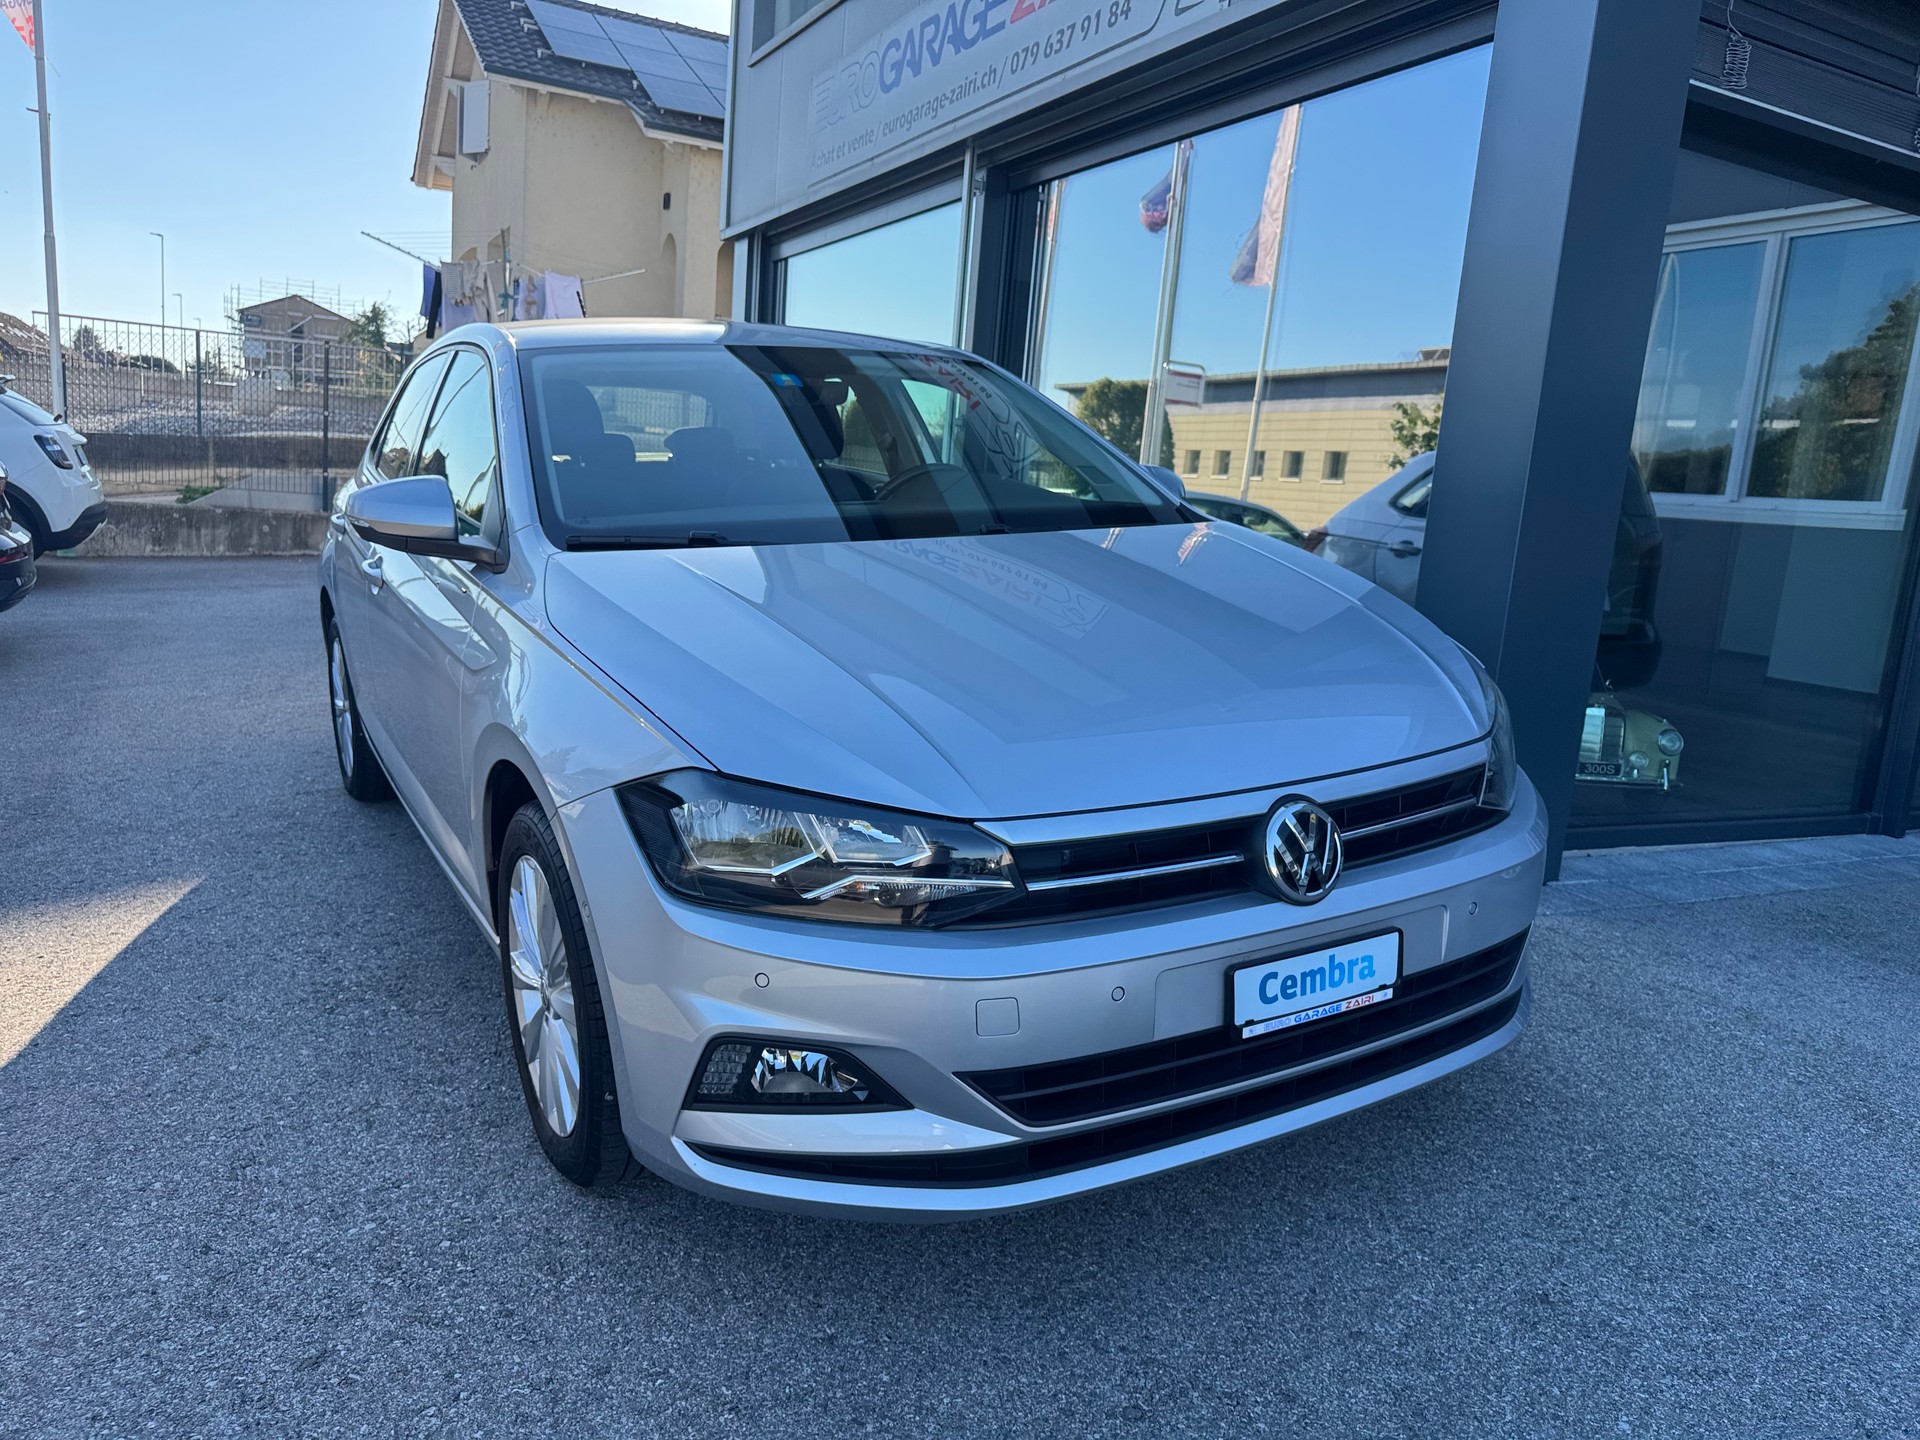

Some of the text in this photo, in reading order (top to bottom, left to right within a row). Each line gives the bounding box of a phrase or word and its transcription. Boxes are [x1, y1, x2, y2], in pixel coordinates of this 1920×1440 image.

[837, 141, 846, 159] et
[848, 130, 875, 153] vente
[882, 64, 997, 132] eurogarage-zairi.ch
[1010, 41, 1040, 75] 079
[1043, 23, 1076, 59] 637
[1080, 9, 1101, 41] 91
[1107, 0, 1132, 28] 84
[1584, 764, 1615, 774] 300S
[1258, 953, 1376, 1005] Cembra
[1263, 995, 1375, 1031] EURO GARAGE ZAIRI
